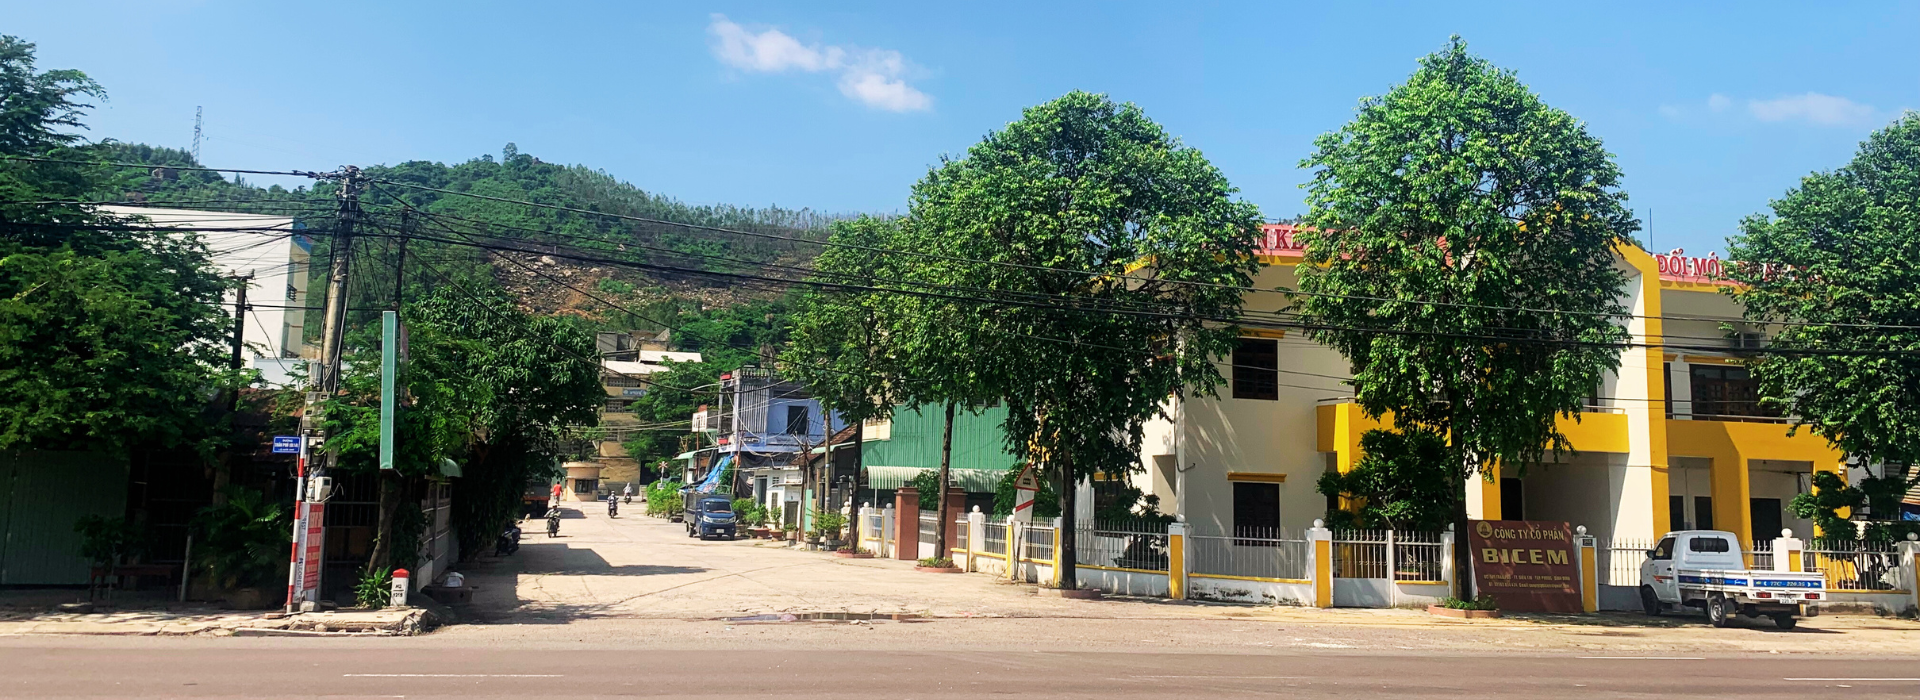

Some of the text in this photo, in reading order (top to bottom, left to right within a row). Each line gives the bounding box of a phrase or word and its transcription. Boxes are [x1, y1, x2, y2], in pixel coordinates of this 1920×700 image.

[1655, 248, 1688, 275] ĐỔI
[1494, 524, 1564, 540] CÔNG TY CỔ PHẦN
[1481, 548, 1569, 565] BICEM
